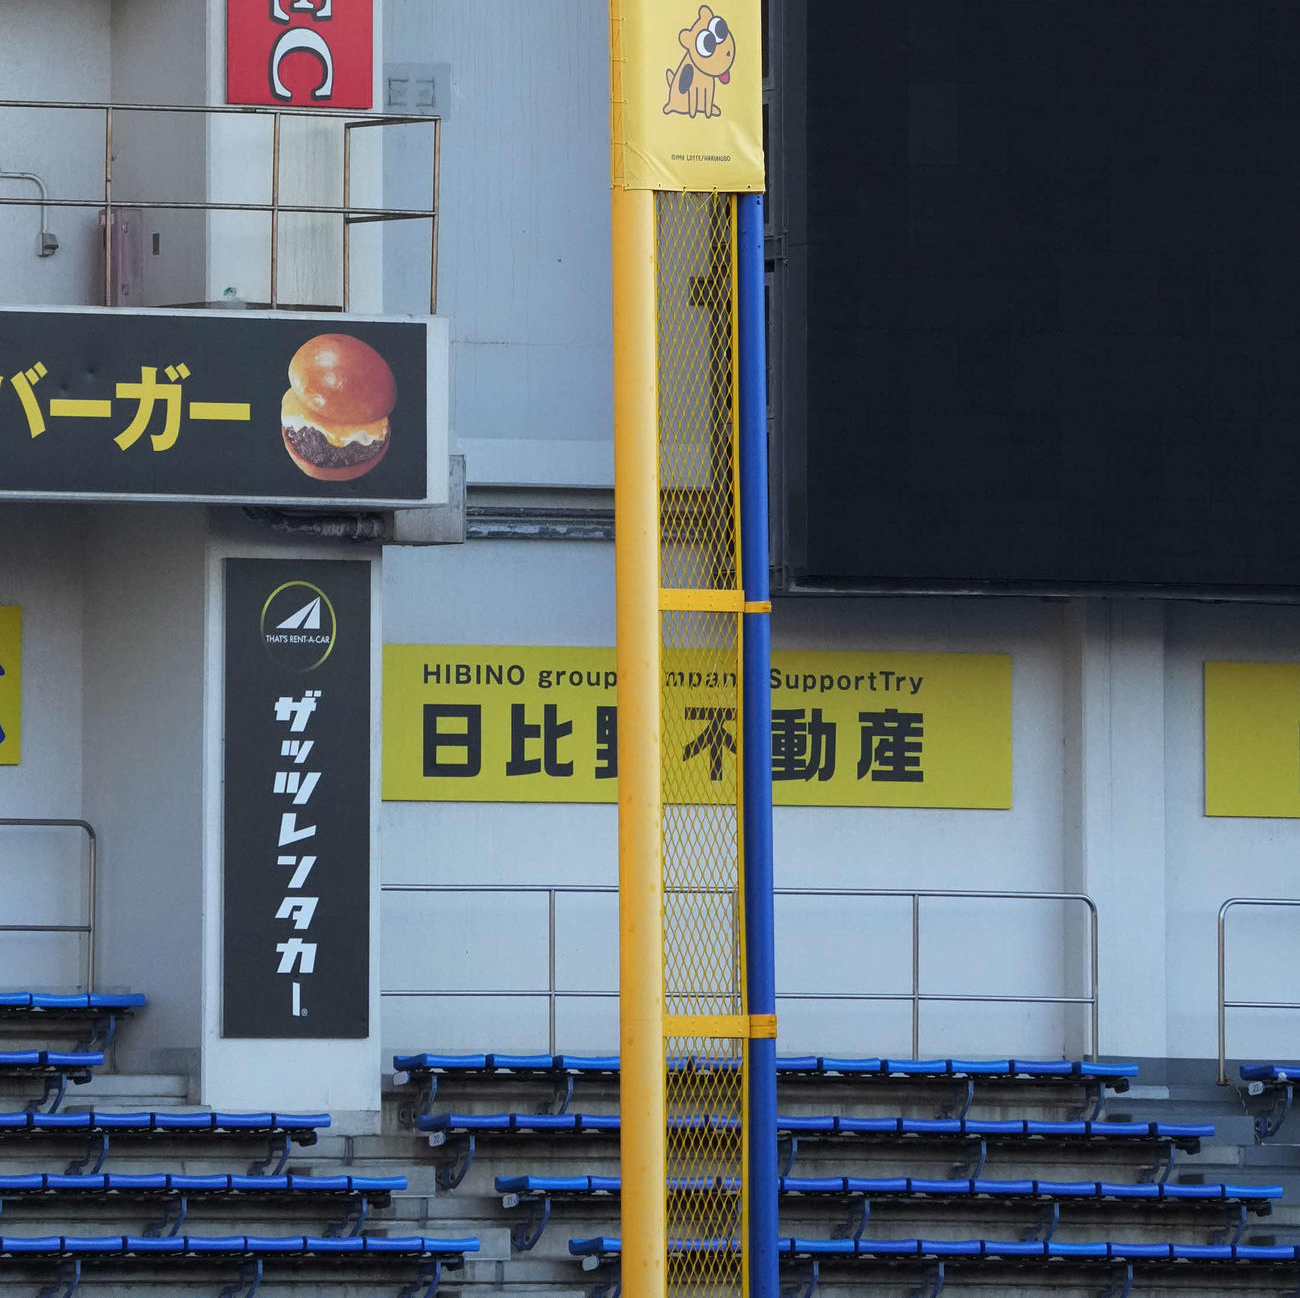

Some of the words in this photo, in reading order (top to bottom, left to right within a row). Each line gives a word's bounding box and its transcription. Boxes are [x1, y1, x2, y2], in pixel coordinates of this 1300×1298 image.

[266, 634, 288, 643] THAT'S
[289, 635, 330, 644] RENT-A-CAR
[422, 663, 525, 687] HIBINO
[537, 665, 617, 690] group
[666, 671, 737, 688] mpan
[273, 690, 322, 1017] ザッツレンタカー
